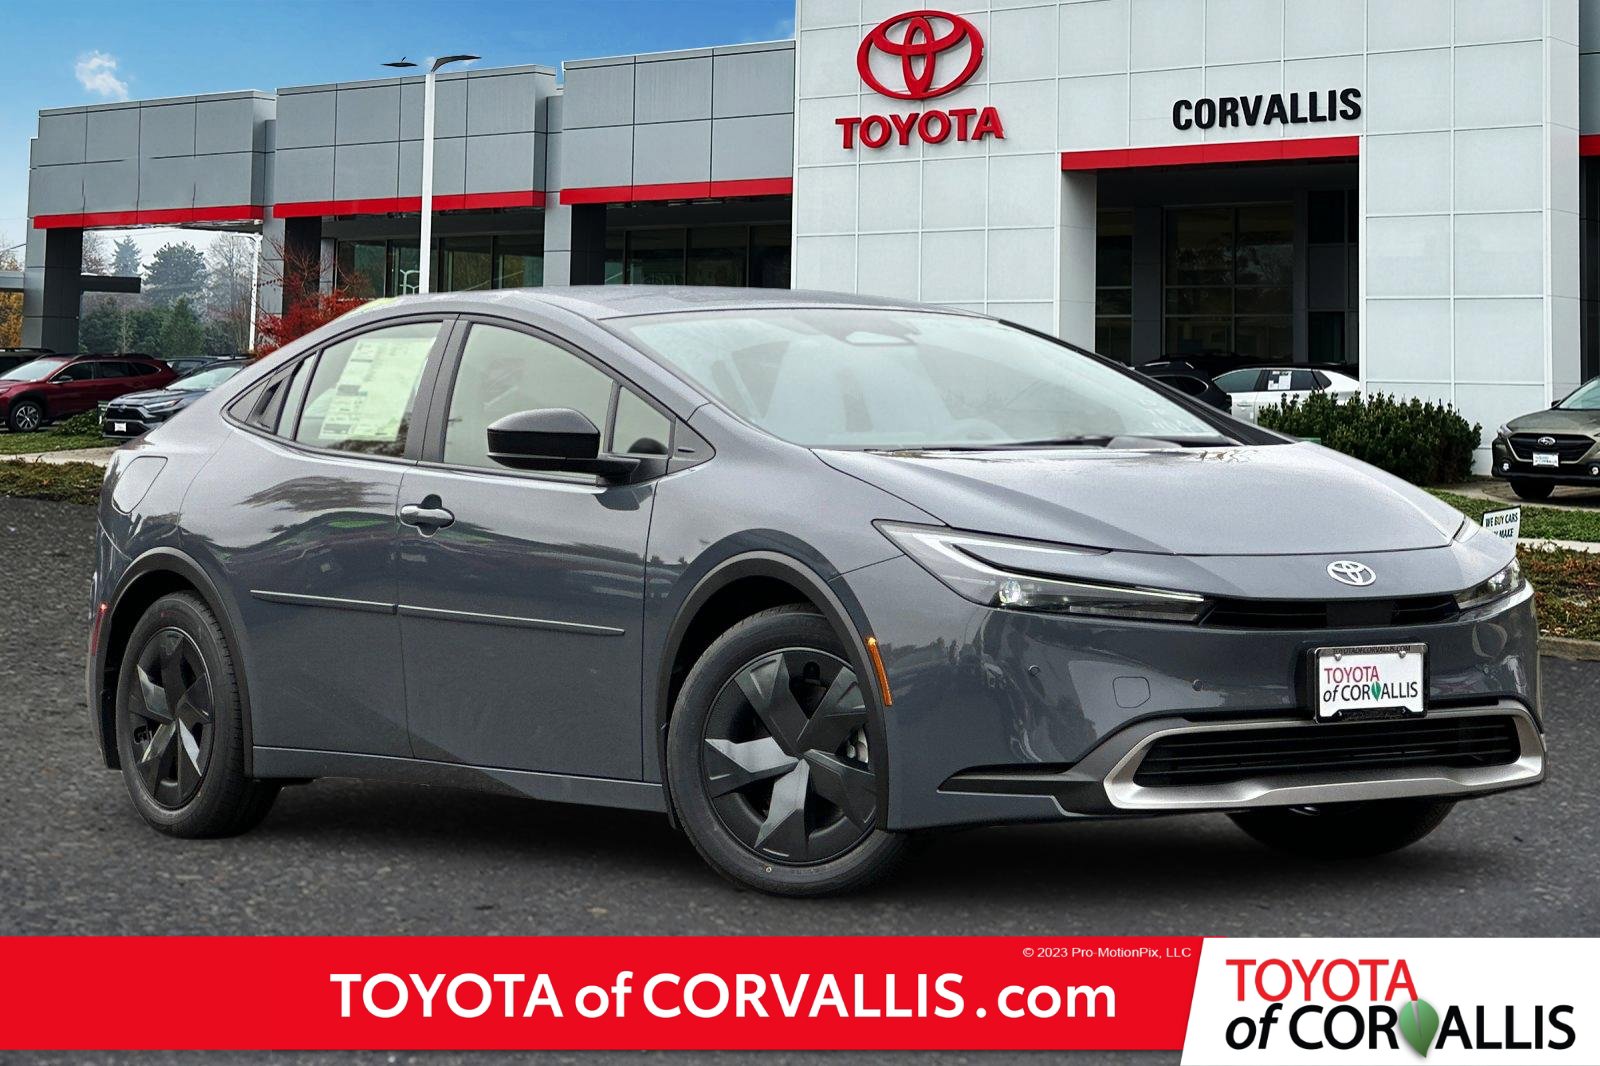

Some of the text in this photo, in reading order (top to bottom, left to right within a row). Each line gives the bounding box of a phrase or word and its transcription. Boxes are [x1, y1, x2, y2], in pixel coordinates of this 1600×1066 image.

[1172, 87, 1362, 131] CORVALLIS
[836, 106, 1005, 149] TOYOTA
[1494, 515, 1504, 526] BUY
[1505, 512, 1518, 524] CARS
[1323, 665, 1380, 684] TOYOTA
[1323, 684, 1340, 702] of
